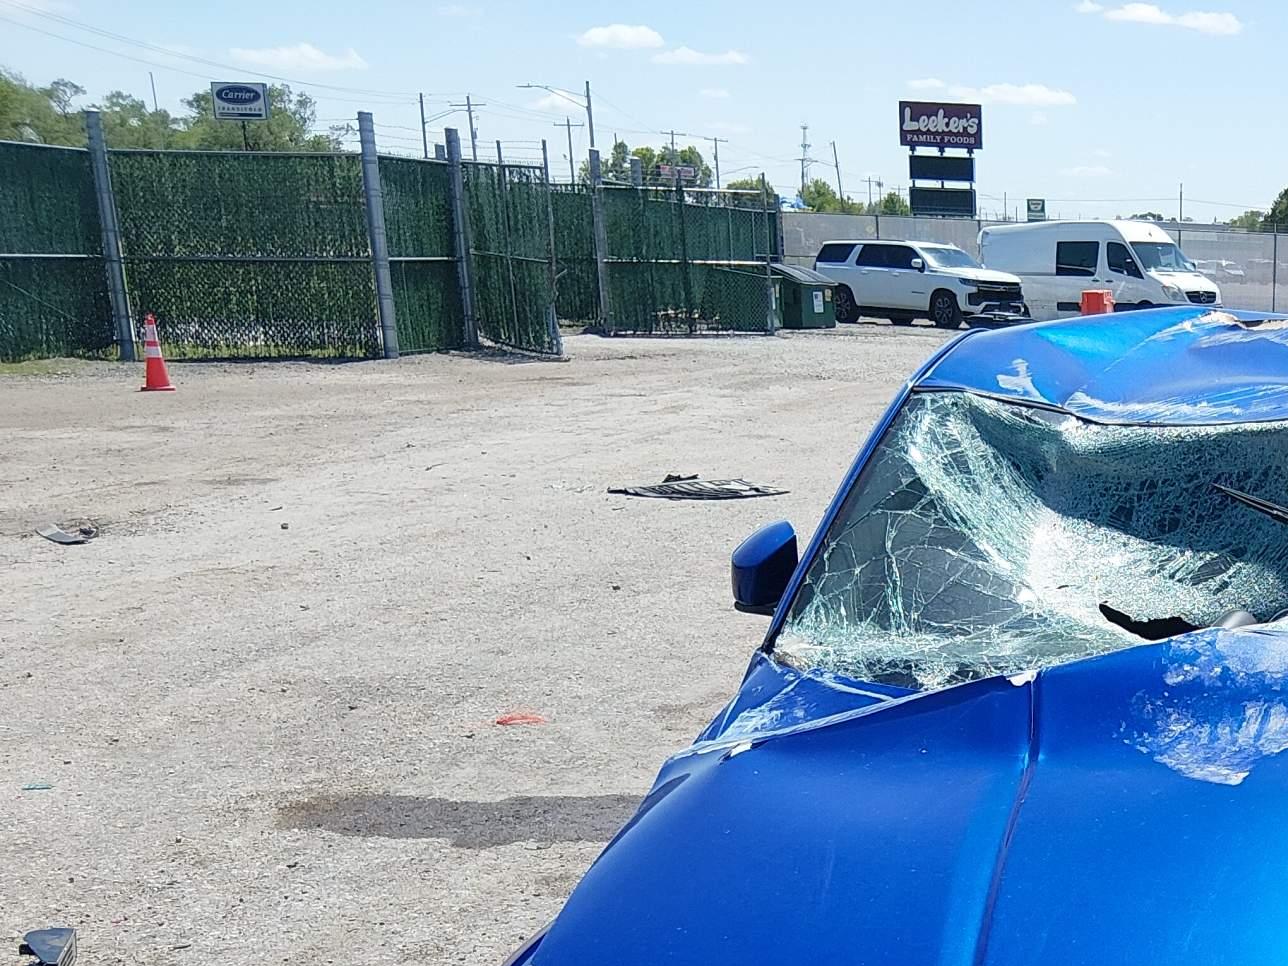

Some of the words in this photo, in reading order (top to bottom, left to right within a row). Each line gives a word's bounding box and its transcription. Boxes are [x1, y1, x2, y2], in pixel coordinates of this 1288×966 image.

[222, 89, 256, 100] Carrier
[902, 107, 979, 134] Leeker's
[906, 134, 941, 143] FAMILY
[944, 136, 975, 144] FOODS
